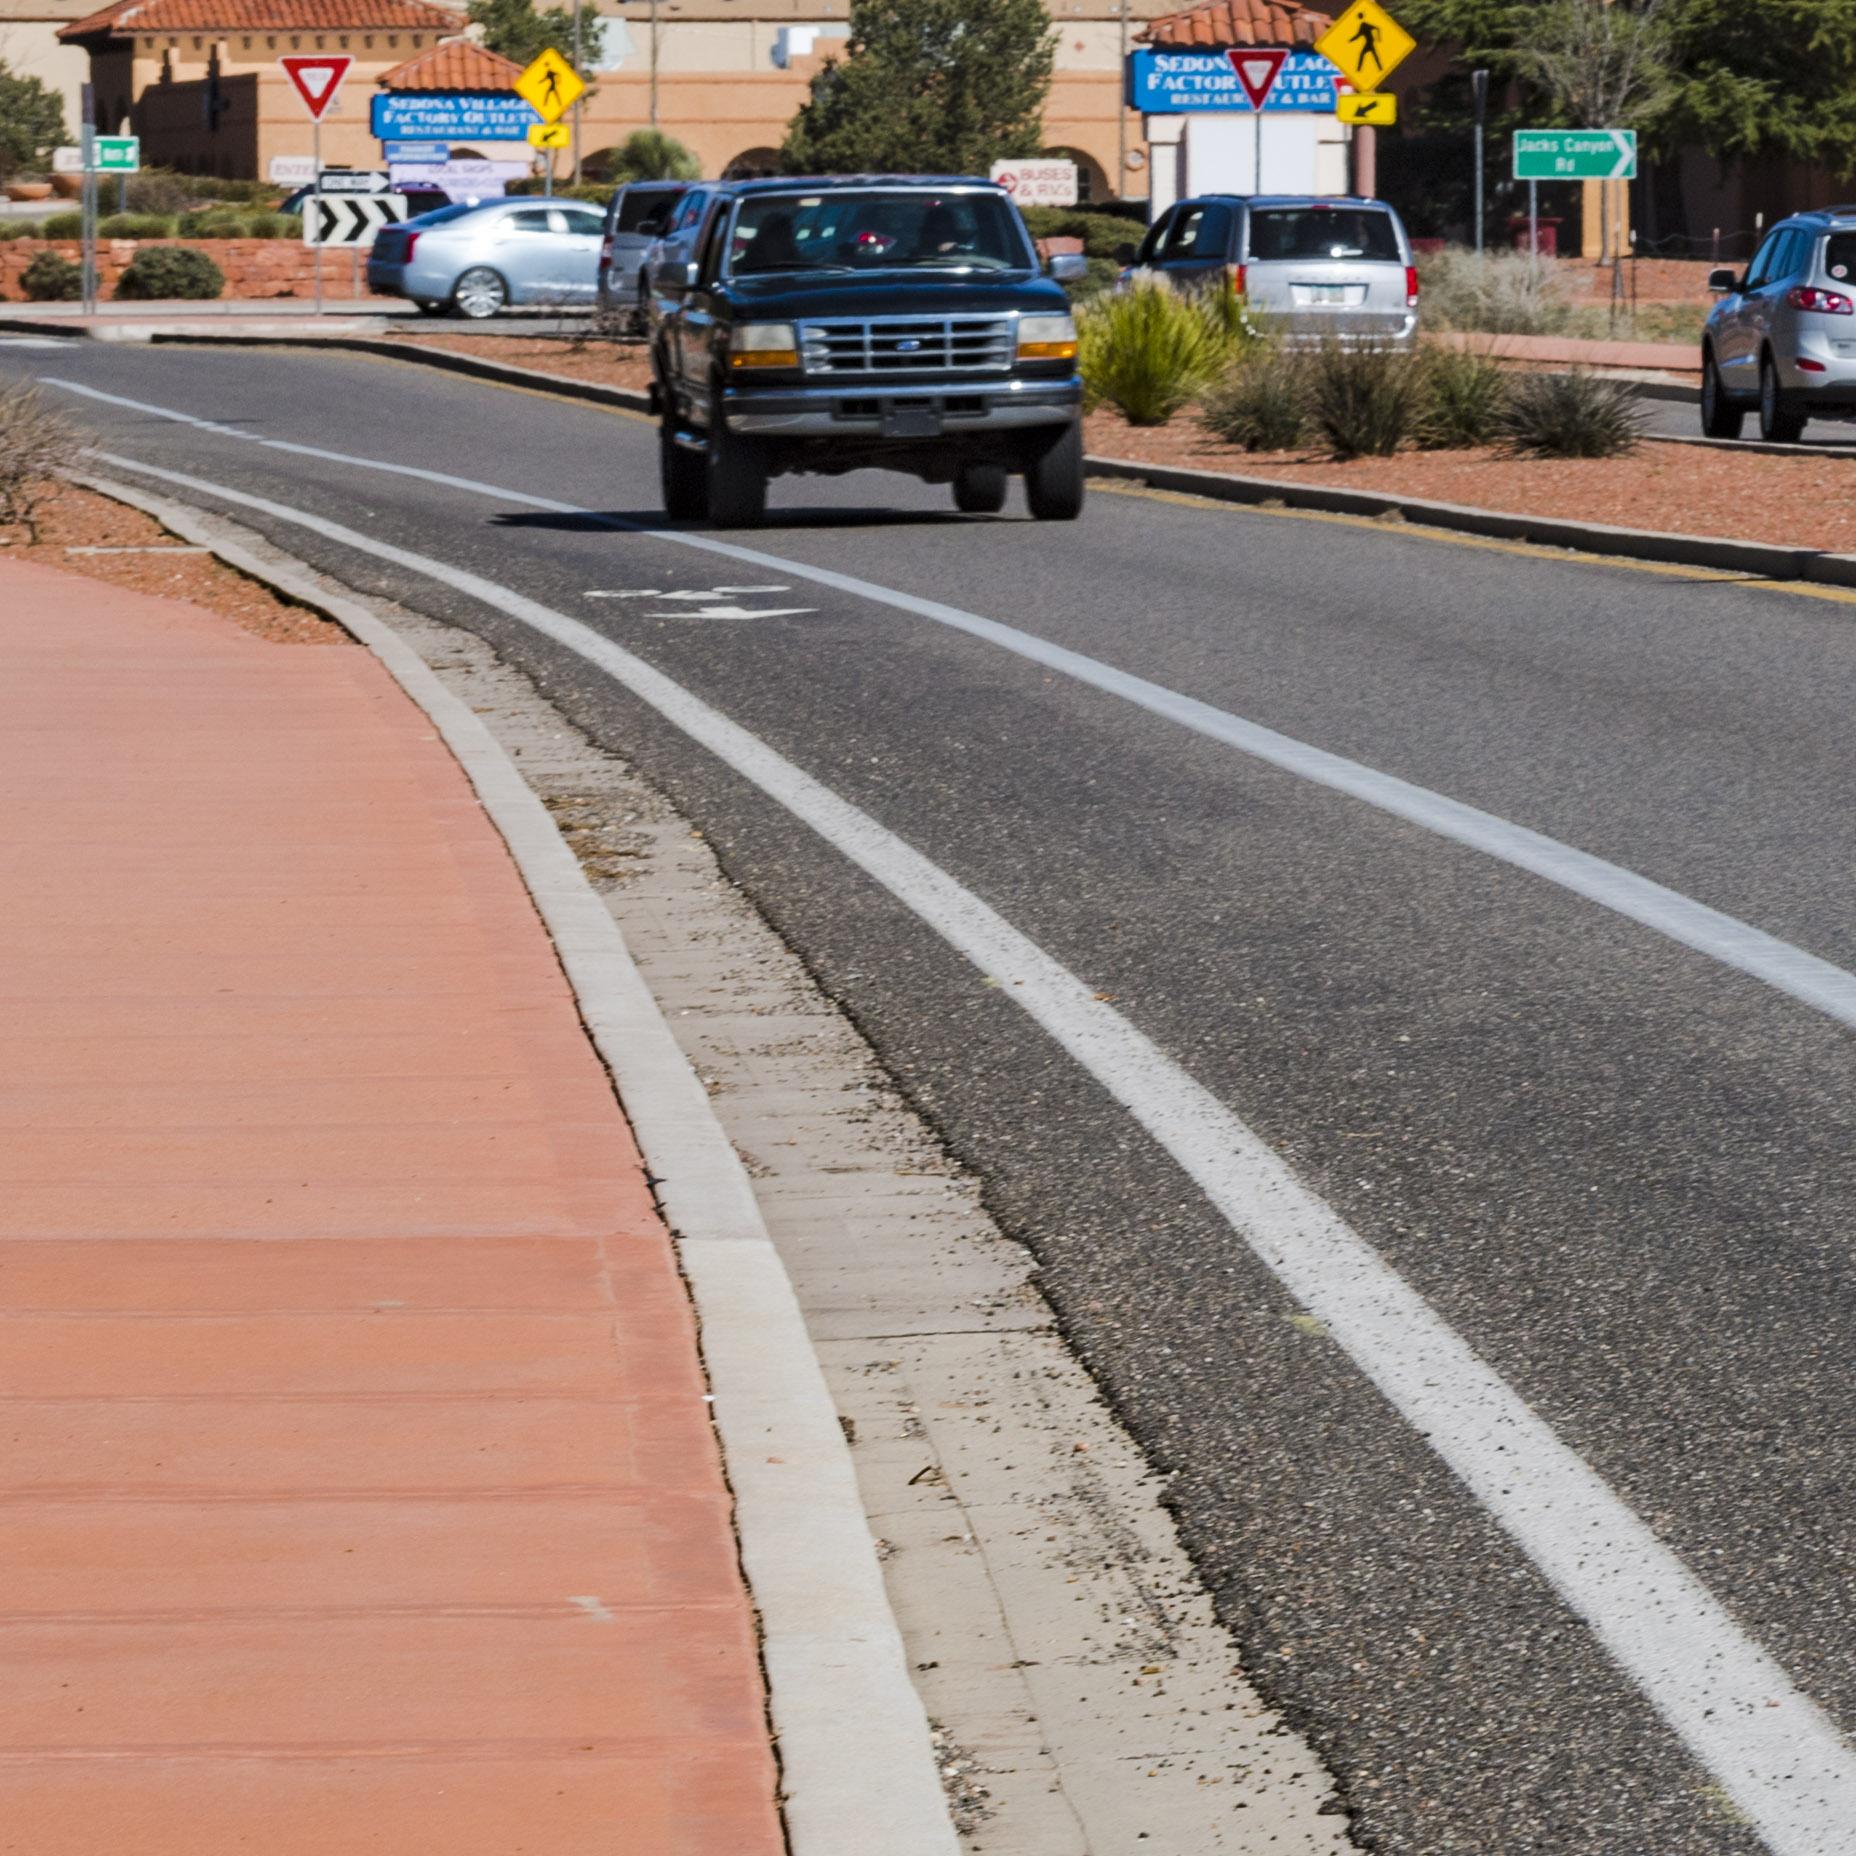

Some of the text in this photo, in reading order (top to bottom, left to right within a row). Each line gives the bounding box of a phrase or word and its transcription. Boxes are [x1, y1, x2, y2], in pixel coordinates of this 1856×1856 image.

[1154, 54, 1234, 72] SEDON
[1147, 73, 1237, 90] FACTOR
[388, 97, 455, 111] SEDONA
[1298, 93, 1331, 105] BAR
[383, 111, 458, 124] FACTORY
[1519, 137, 1616, 155] Jacks Canyon
[1555, 156, 1576, 173] Rd
[1020, 168, 1072, 181] BUSES
